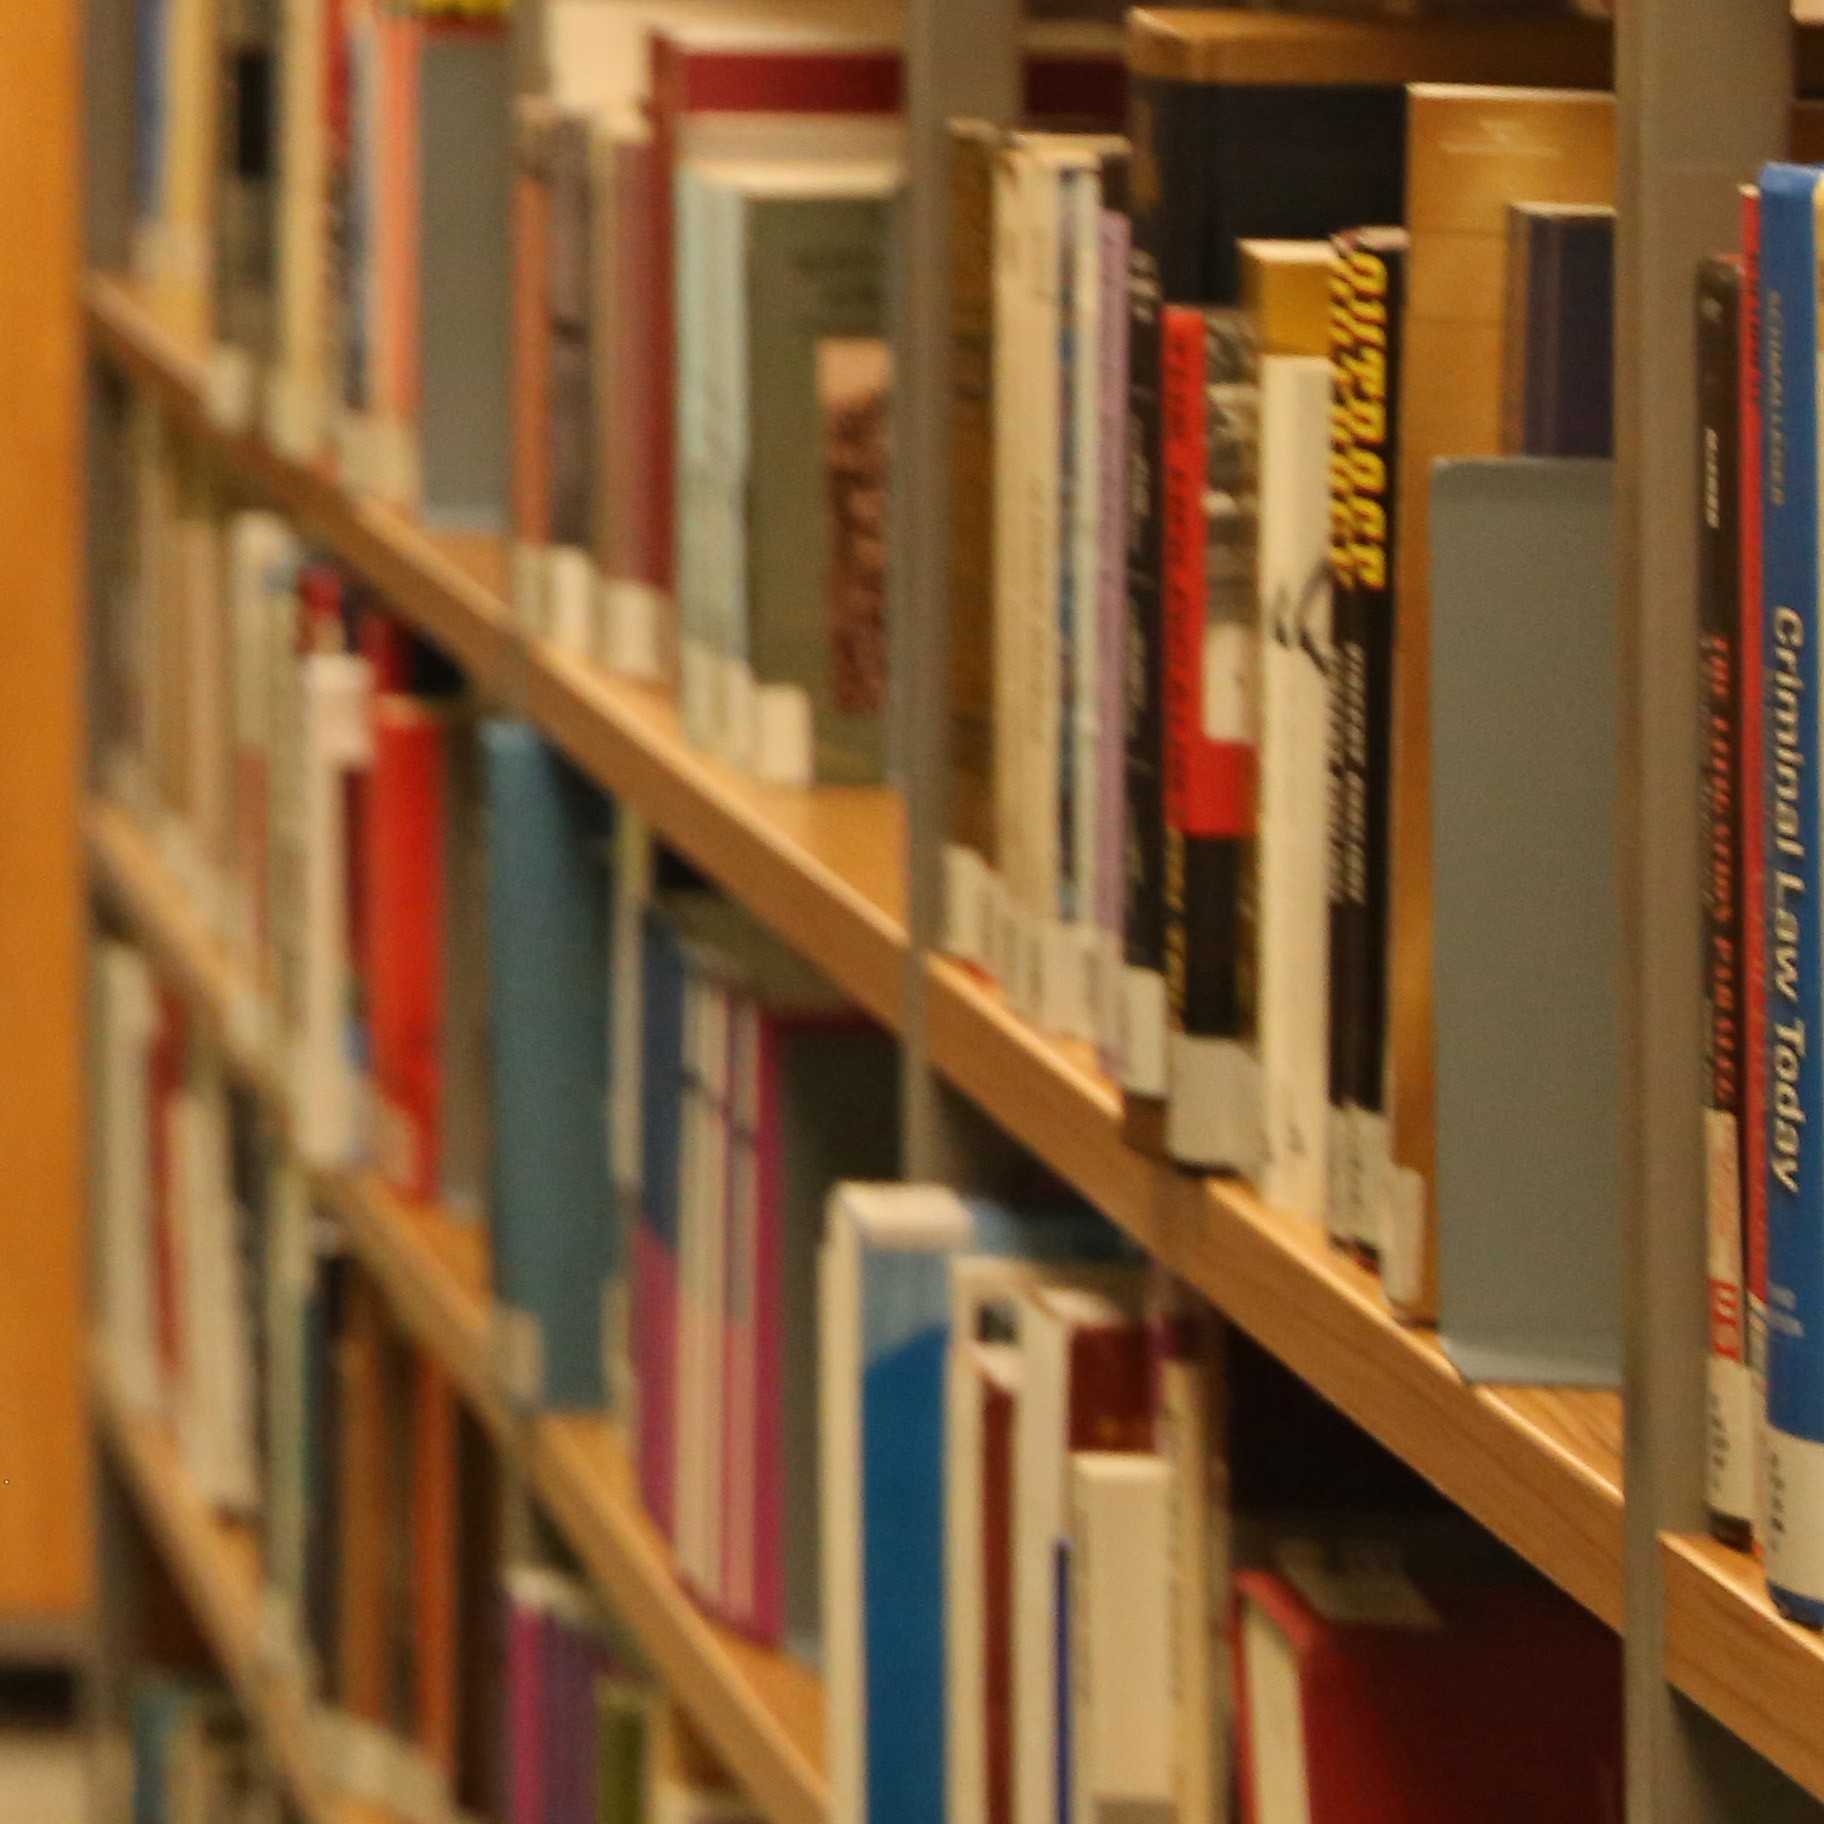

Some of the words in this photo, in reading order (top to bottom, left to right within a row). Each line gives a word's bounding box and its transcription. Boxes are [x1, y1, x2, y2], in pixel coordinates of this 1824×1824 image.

[1771, 606, 1805, 857] Criminal
[1770, 872, 1805, 1003] Law
[1769, 1019, 1805, 1197] Today
